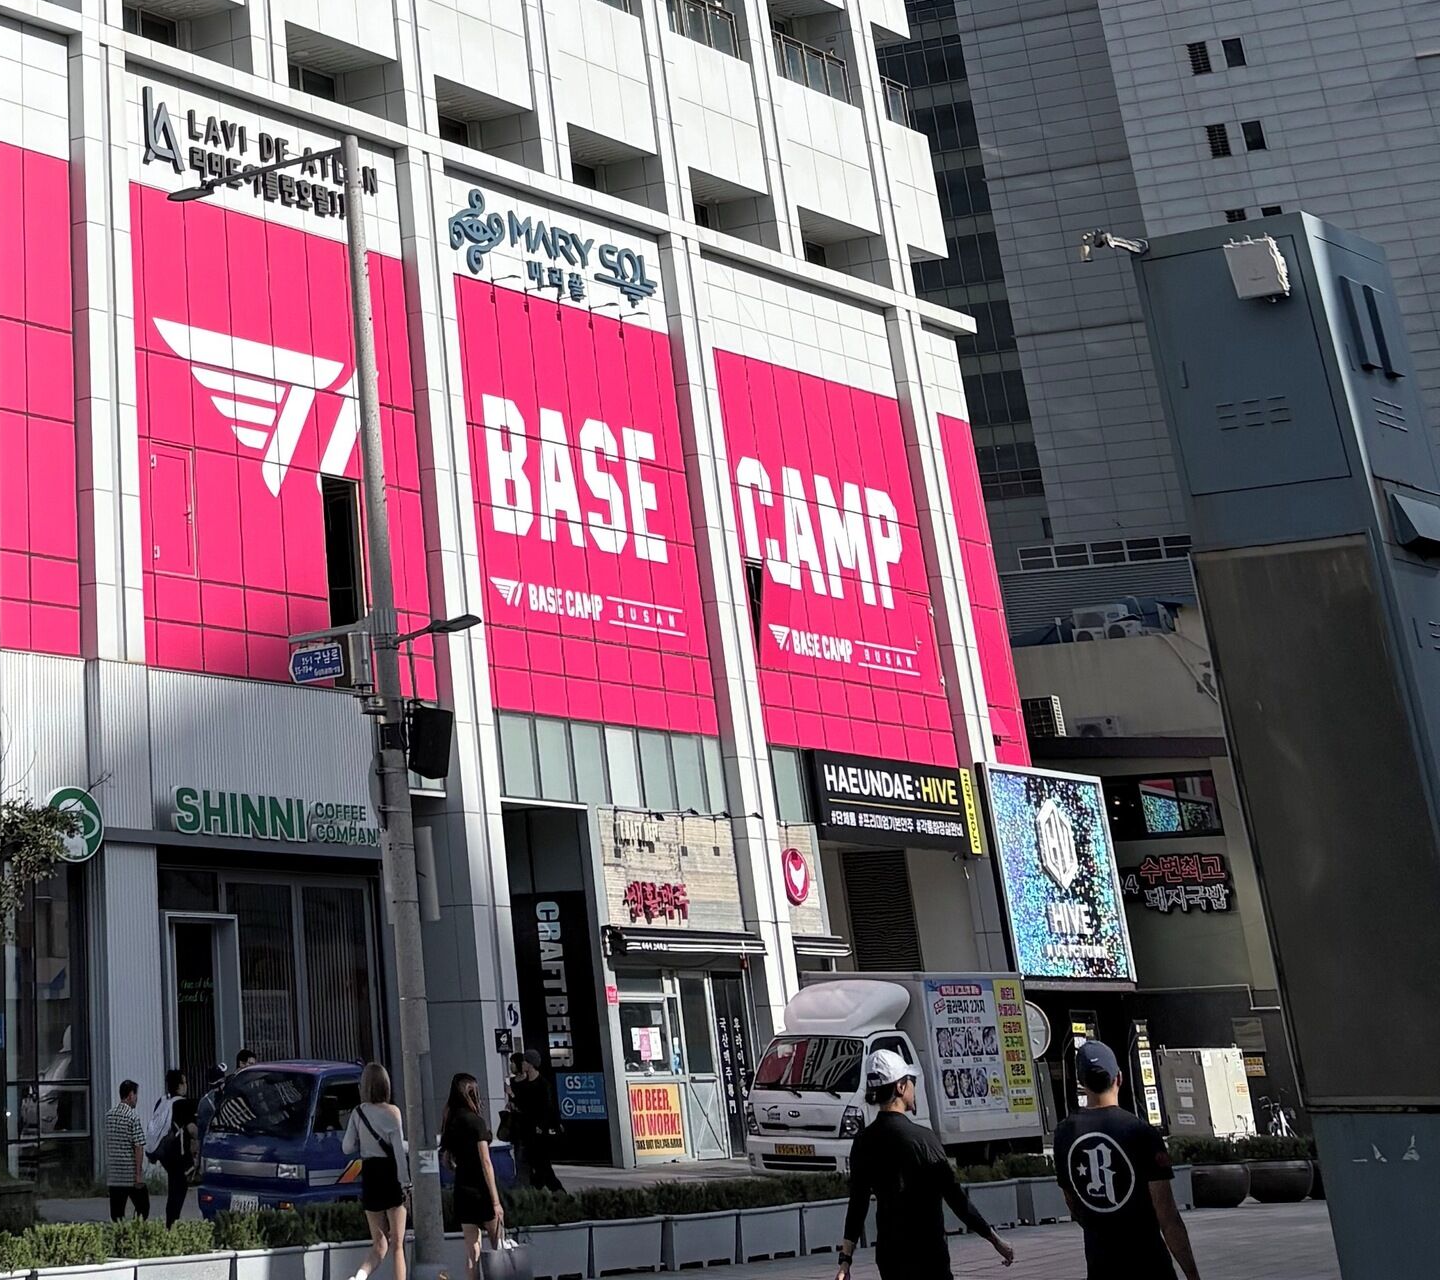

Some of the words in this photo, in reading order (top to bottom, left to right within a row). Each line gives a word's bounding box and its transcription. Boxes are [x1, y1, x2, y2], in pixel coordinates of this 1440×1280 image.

[187, 109, 247, 155] LAVI
[300, 147, 379, 197] ATLN
[507, 210, 595, 269] MARY
[598, 243, 658, 290] SOL
[482, 393, 669, 564] BASE
[736, 456, 903, 610] CAMP
[528, 583, 564, 616] BASE
[566, 590, 603, 621] CAMP
[617, 605, 675, 628] BUSAN
[791, 629, 822, 659] BASE
[824, 635, 853, 664] CAMP
[864, 648, 912, 668] BUSAN
[174, 786, 308, 841] SHINNI
[315, 802, 367, 822] COFFEE
[316, 823, 381, 845] COMPAN
[1140, 855, 1226, 884] 수변최고
[1144, 884, 1229, 911] 돼지국밥
[1049, 902, 1093, 935] HIVE
[536, 901, 567, 993] CRAFT
[545, 995, 574, 1068] BEER
[565, 1075, 596, 1090] GS25
[630, 1089, 643, 1112] NO
[645, 1088, 672, 1112] BEER,
[632, 1114, 646, 1138] NO
[647, 1111, 681, 1136] WORK!
